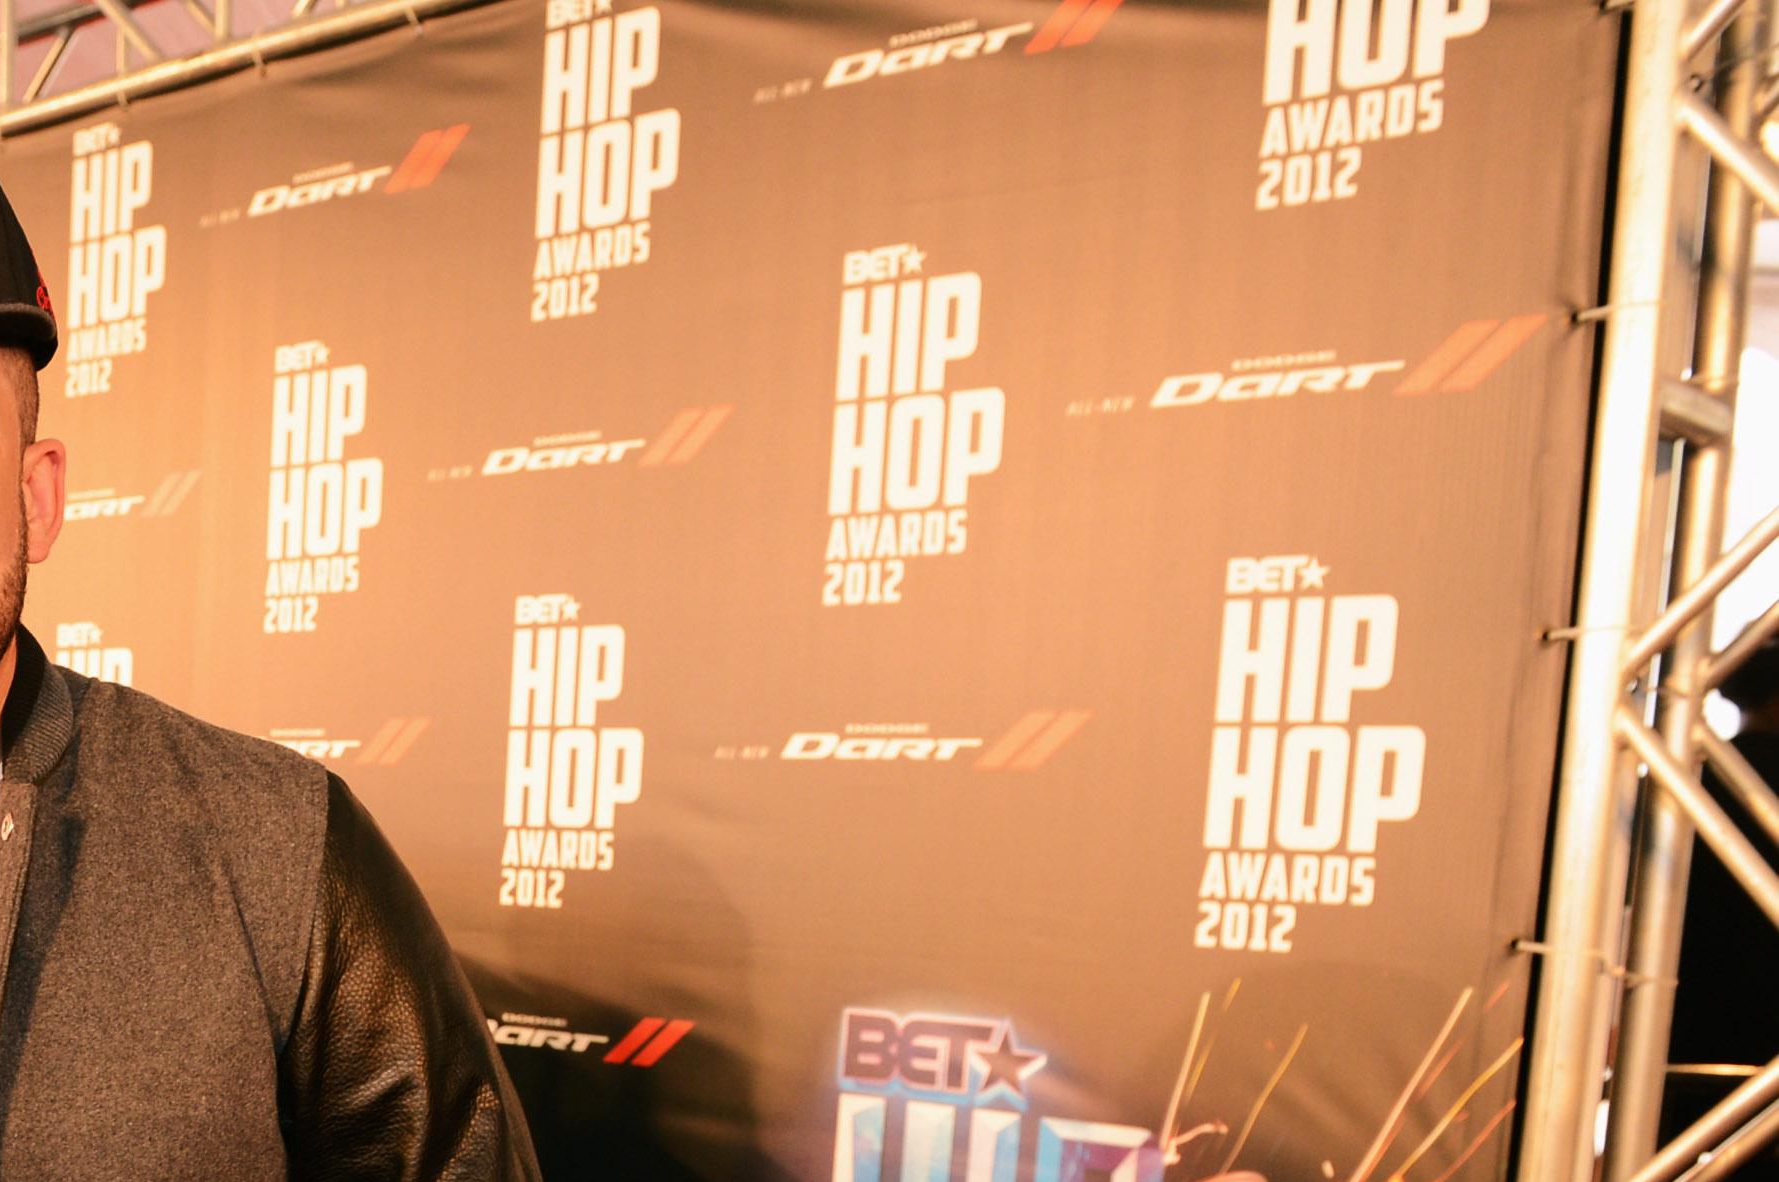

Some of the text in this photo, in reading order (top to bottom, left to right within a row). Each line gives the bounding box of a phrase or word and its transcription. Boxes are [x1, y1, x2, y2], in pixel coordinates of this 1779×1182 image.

[540, 6, 661, 135] HIP
[1262, 0, 1490, 106] HOP
[1259, 78, 1445, 159] AWARDS
[72, 140, 153, 244] HIP
[535, 108, 681, 240] HOP
[1255, 145, 1362, 211] 2012
[68, 224, 167, 329] HOP
[533, 221, 651, 280] AWARDS
[842, 243, 910, 286] BET
[530, 271, 600, 322] 2012
[66, 317, 147, 363] AWARDS
[835, 271, 982, 403] HIP
[65, 358, 112, 398] 2012
[270, 364, 367, 468] HIP
[828, 386, 1006, 516] HOP
[266, 457, 383, 560] HOP
[825, 508, 969, 563] AWARDS
[265, 555, 359, 597] AWARDS
[822, 557, 905, 607] 2012
[1225, 554, 1310, 594] BET
[263, 595, 318, 633] 2012
[509, 624, 626, 727] HIP
[1213, 594, 1400, 724] HIP
[503, 727, 645, 829] HOP
[1202, 724, 1427, 853] HOP
[501, 827, 615, 870] AWARDS
[1198, 851, 1377, 907] AWARDS
[499, 866, 565, 909] 2012
[1194, 901, 1298, 953] 2012
[841, 1009, 1001, 1094] BET
